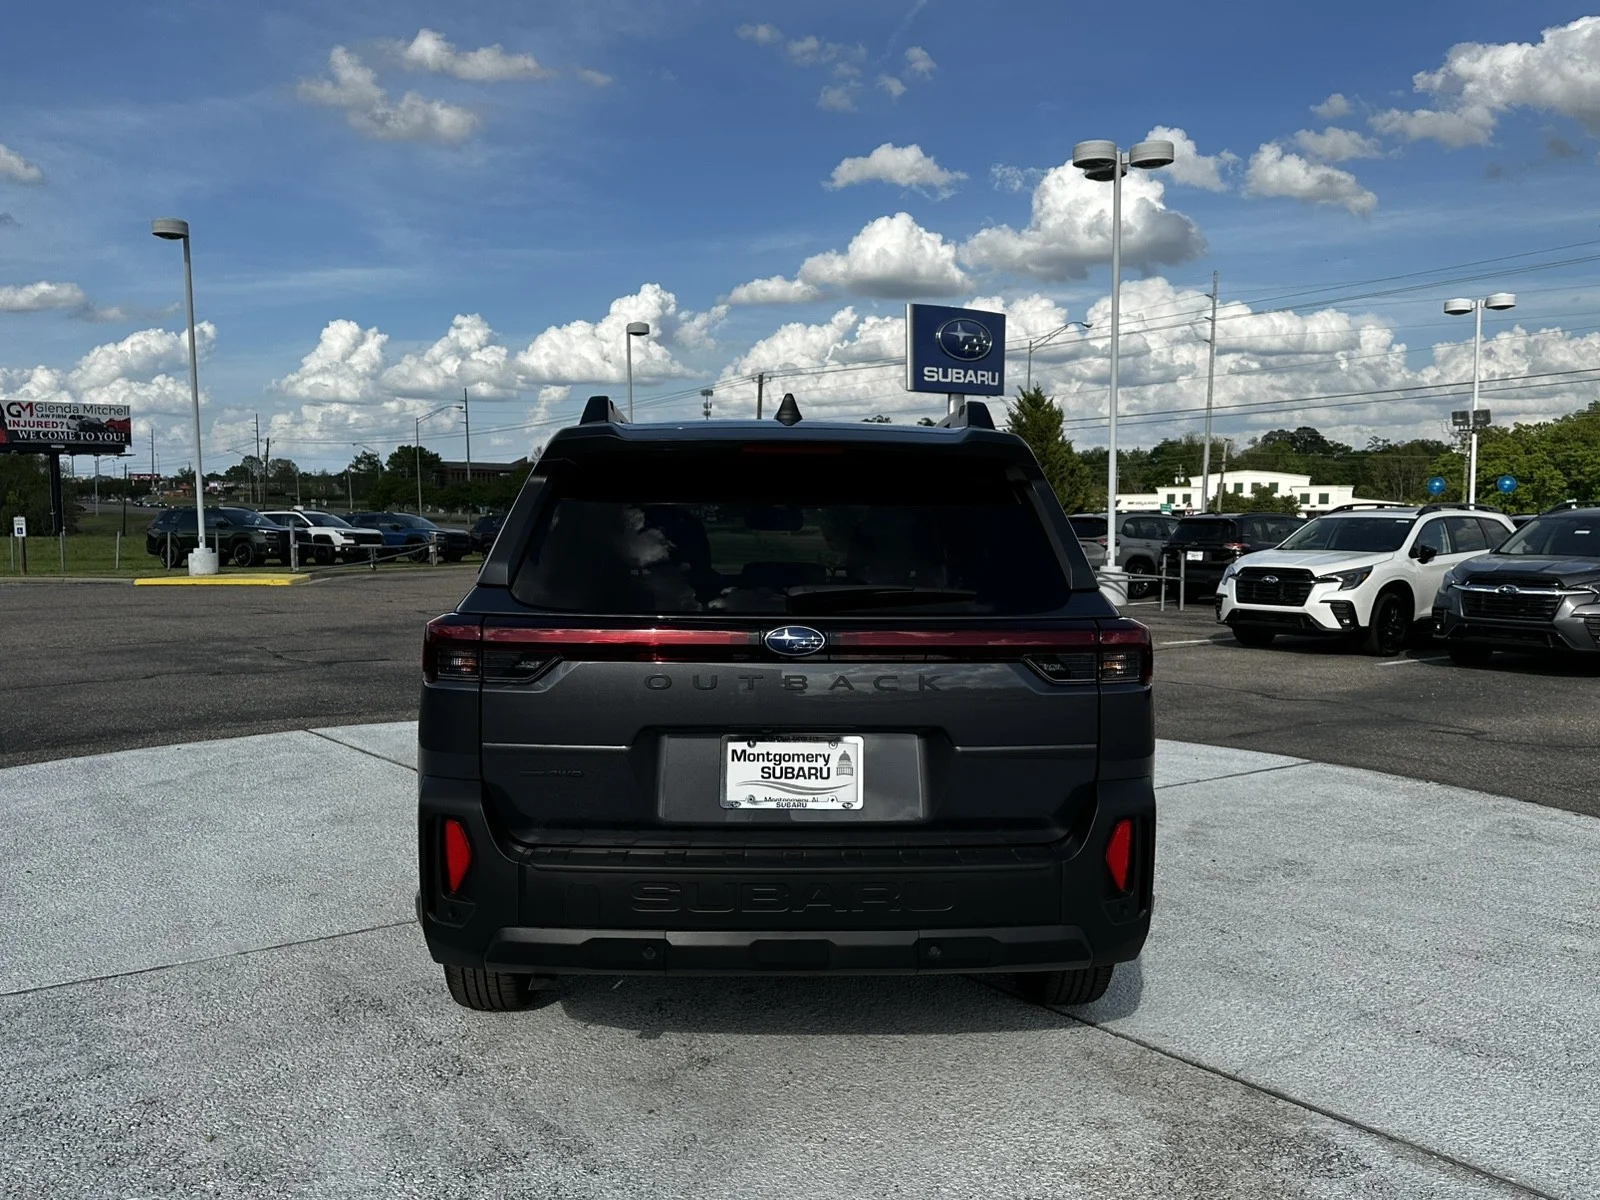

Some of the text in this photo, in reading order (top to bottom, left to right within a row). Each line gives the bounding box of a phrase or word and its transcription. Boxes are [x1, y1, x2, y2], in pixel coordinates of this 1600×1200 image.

[923, 366, 999, 386] SUBARU
[35, 403, 130, 416] Glenda Mitchell
[8, 419, 65, 429] INJURED?
[18, 430, 126, 442] WE COME TO YOU!
[644, 673, 943, 691] OUTBACK
[731, 749, 831, 766] Montgomery
[761, 766, 831, 780] SUBARU
[630, 879, 955, 913] SUBARU
